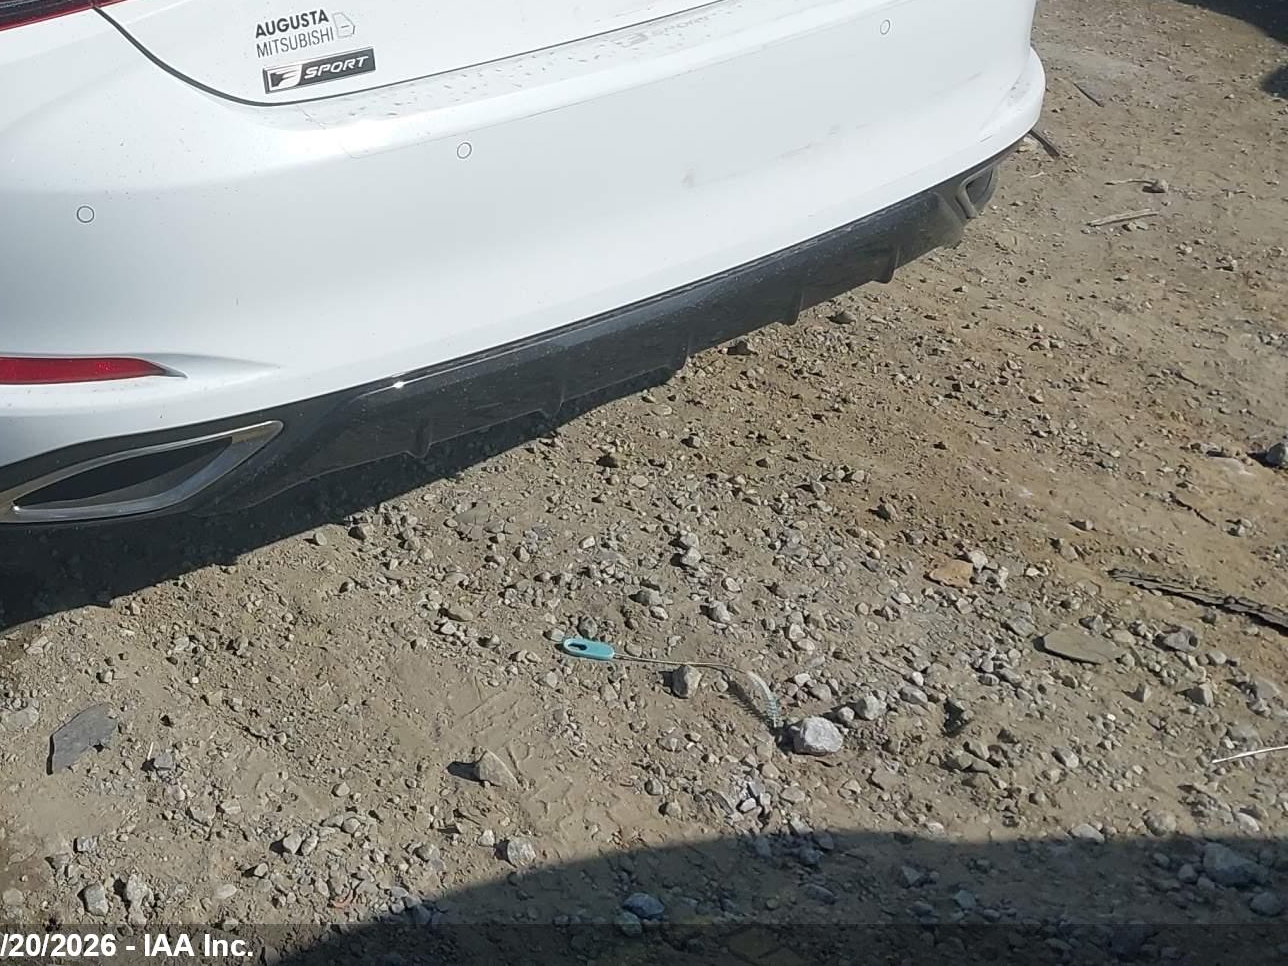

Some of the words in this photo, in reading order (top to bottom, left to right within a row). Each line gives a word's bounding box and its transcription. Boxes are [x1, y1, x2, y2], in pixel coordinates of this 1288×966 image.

[255, 9, 330, 39] AUGUSTA
[256, 26, 335, 59] MITSUBISHI
[303, 55, 369, 80] SPORT
